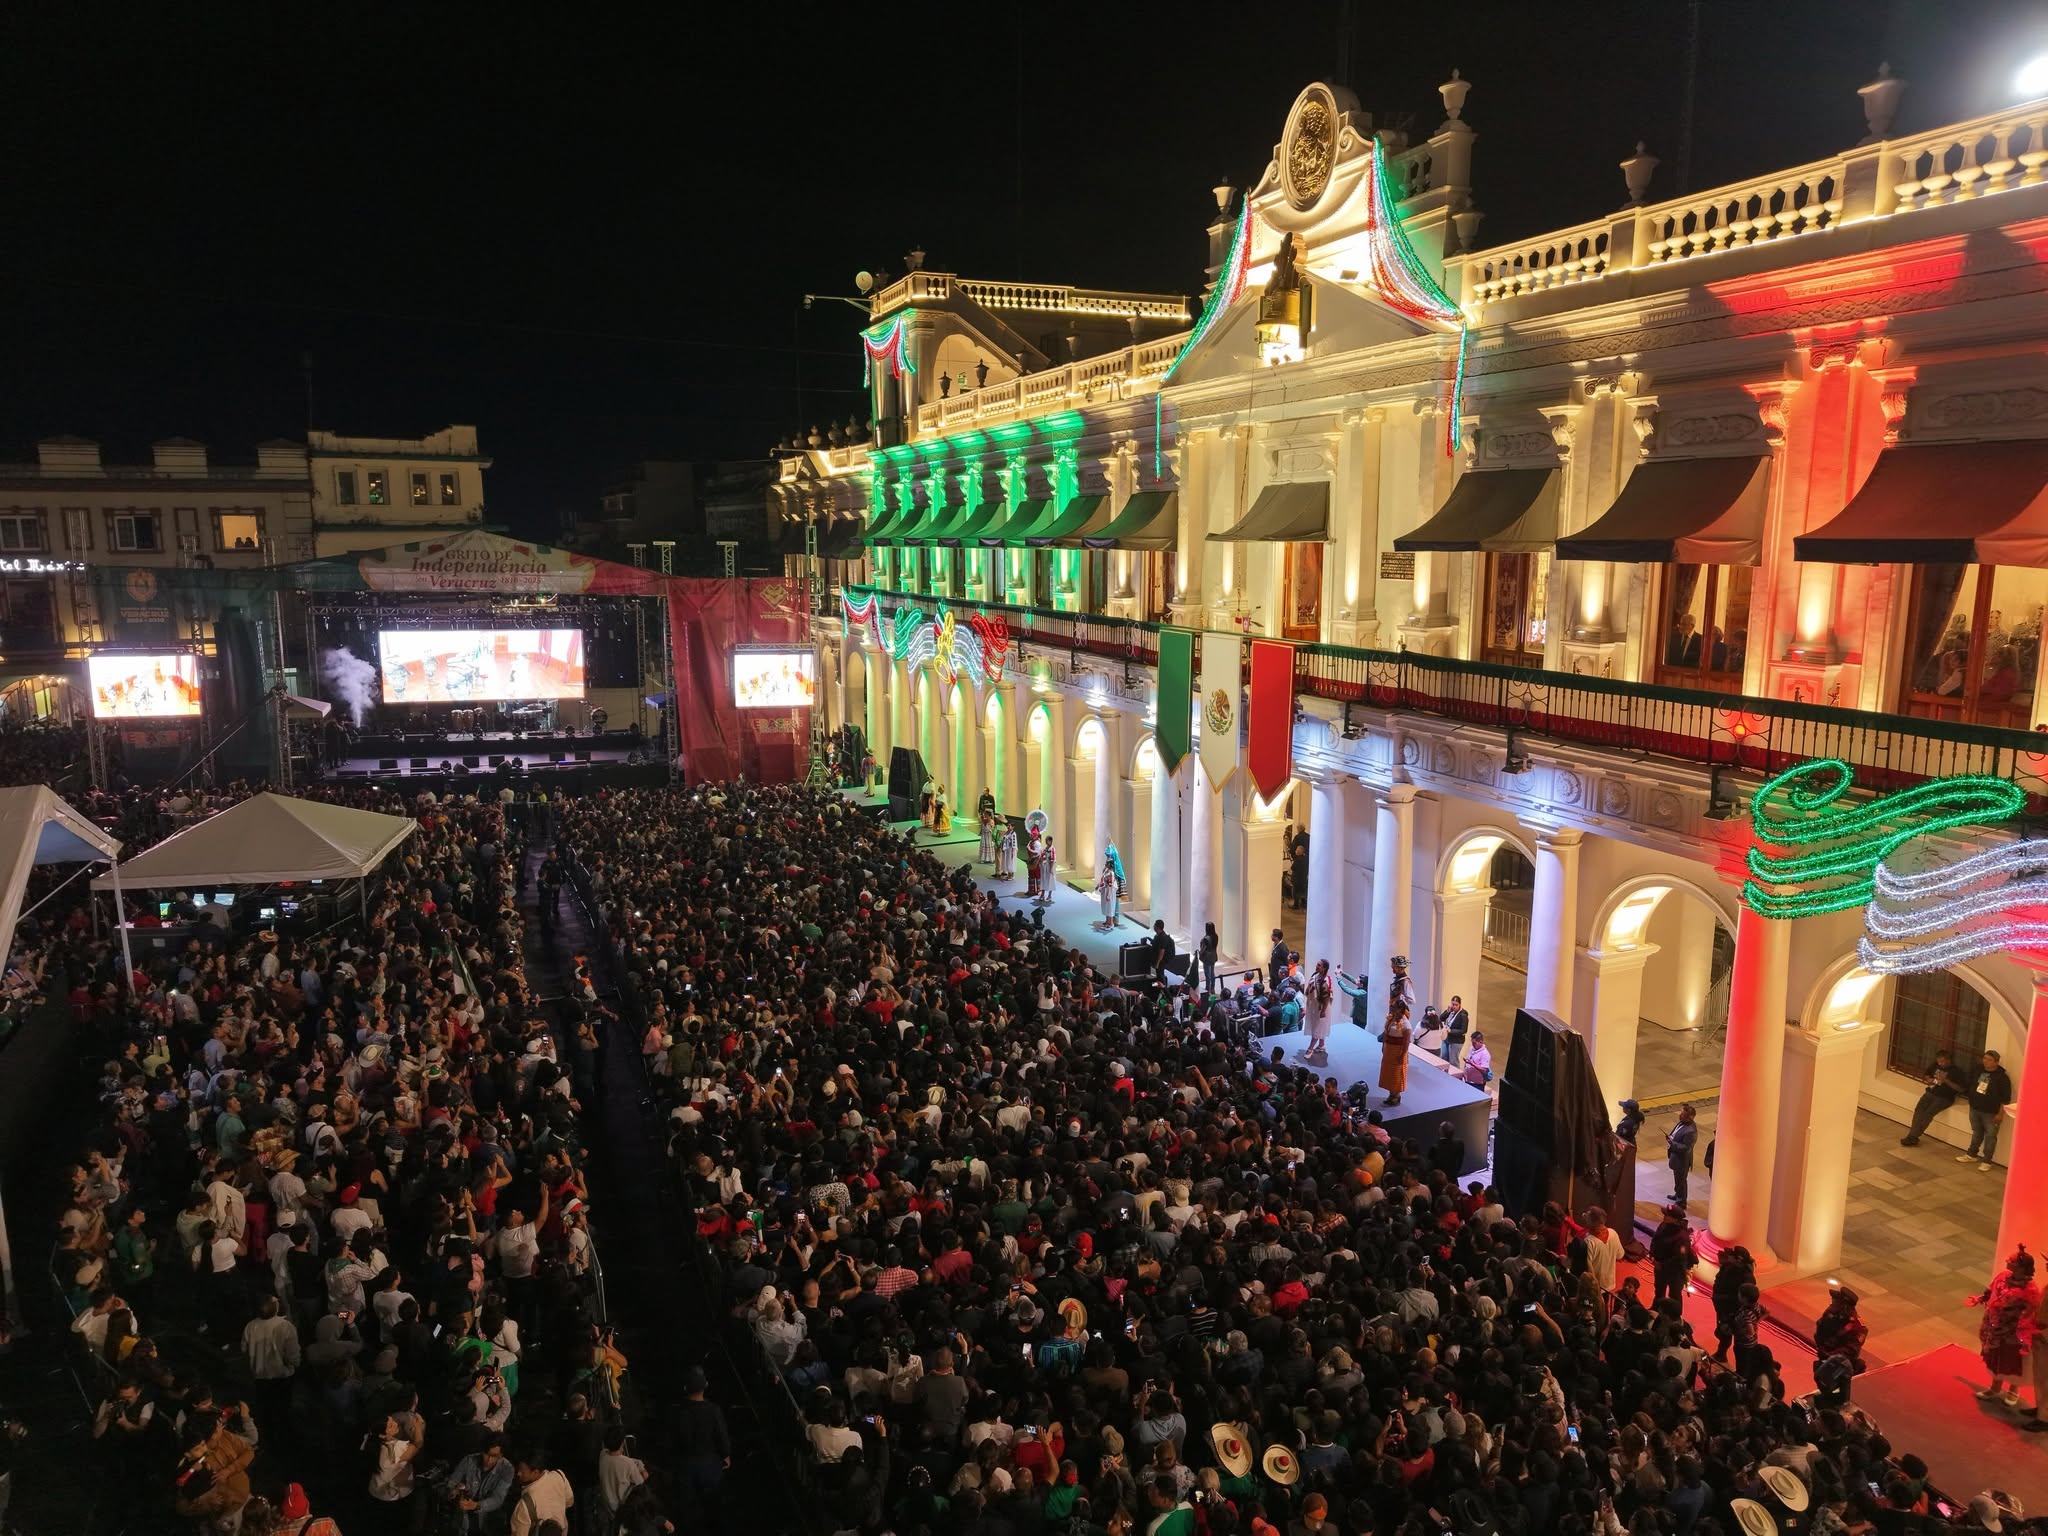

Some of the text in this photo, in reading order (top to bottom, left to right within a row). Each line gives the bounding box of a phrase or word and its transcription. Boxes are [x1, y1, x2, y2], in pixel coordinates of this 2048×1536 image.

[446, 549, 513, 561] GRITO DE
[411, 557, 546, 576] Independencia
[430, 575, 497, 589] Veracruz
